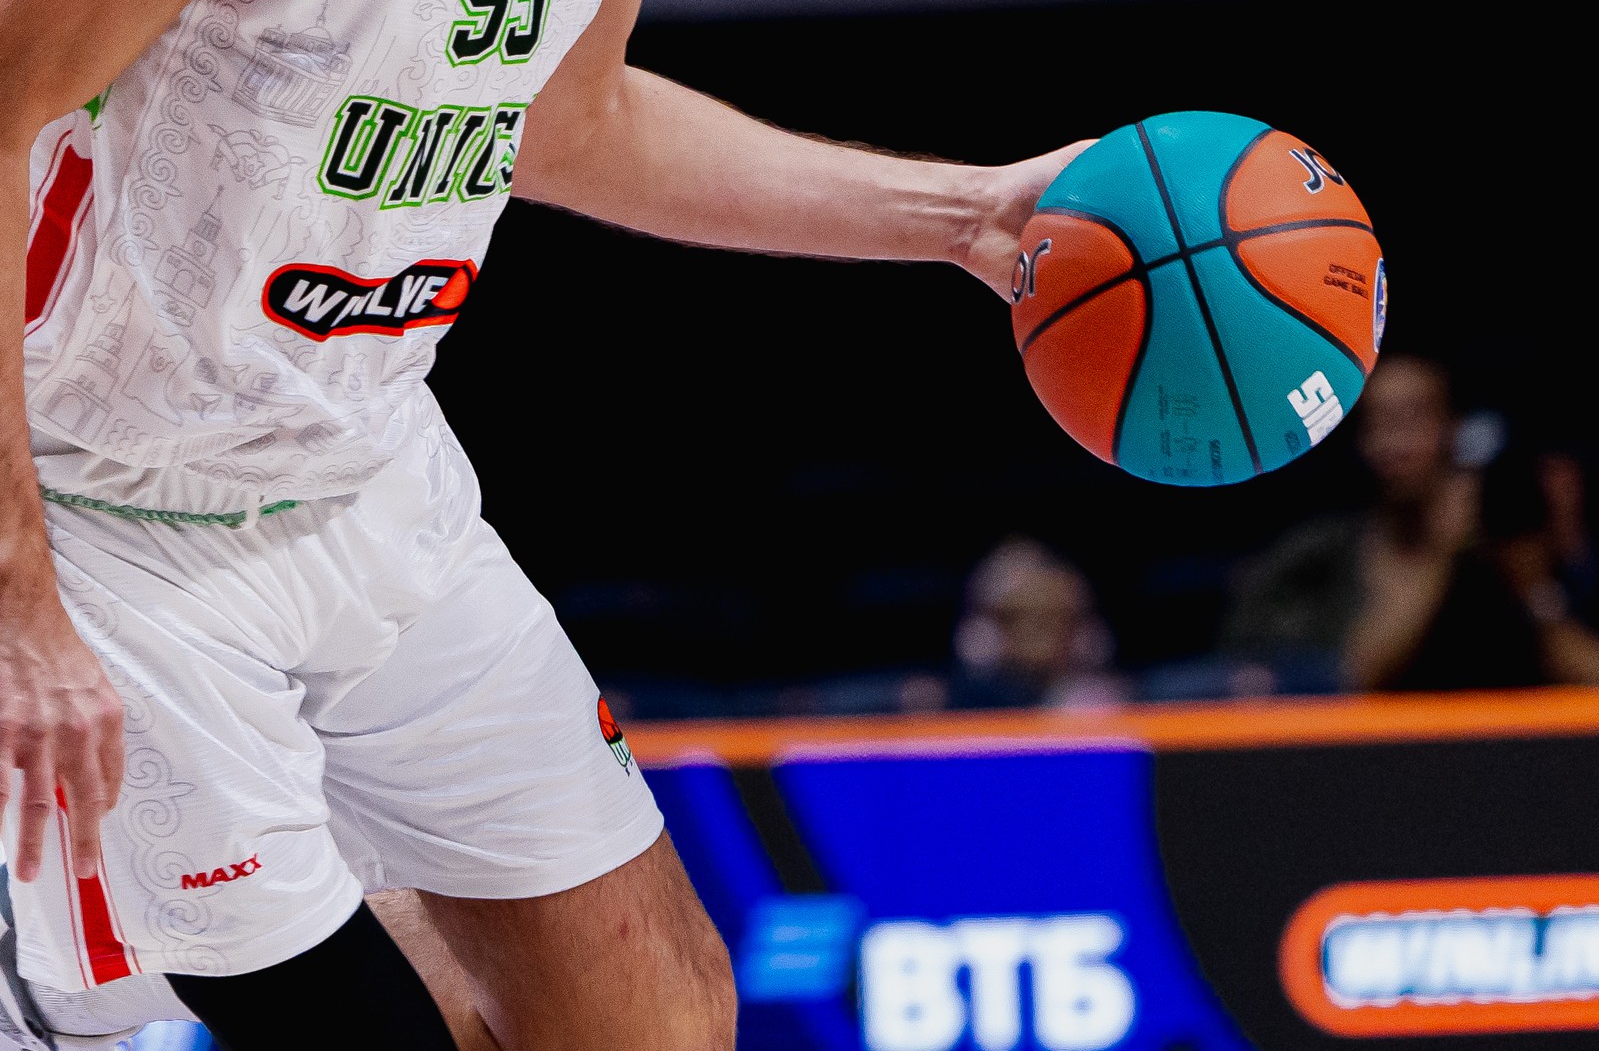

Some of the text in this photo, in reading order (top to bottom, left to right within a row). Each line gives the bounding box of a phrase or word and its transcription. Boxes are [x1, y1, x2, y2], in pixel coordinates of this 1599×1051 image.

[317, 96, 527, 210] UNIC
[181, 852, 263, 890] MAXX
[860, 915, 1135, 1051] ВТБ
